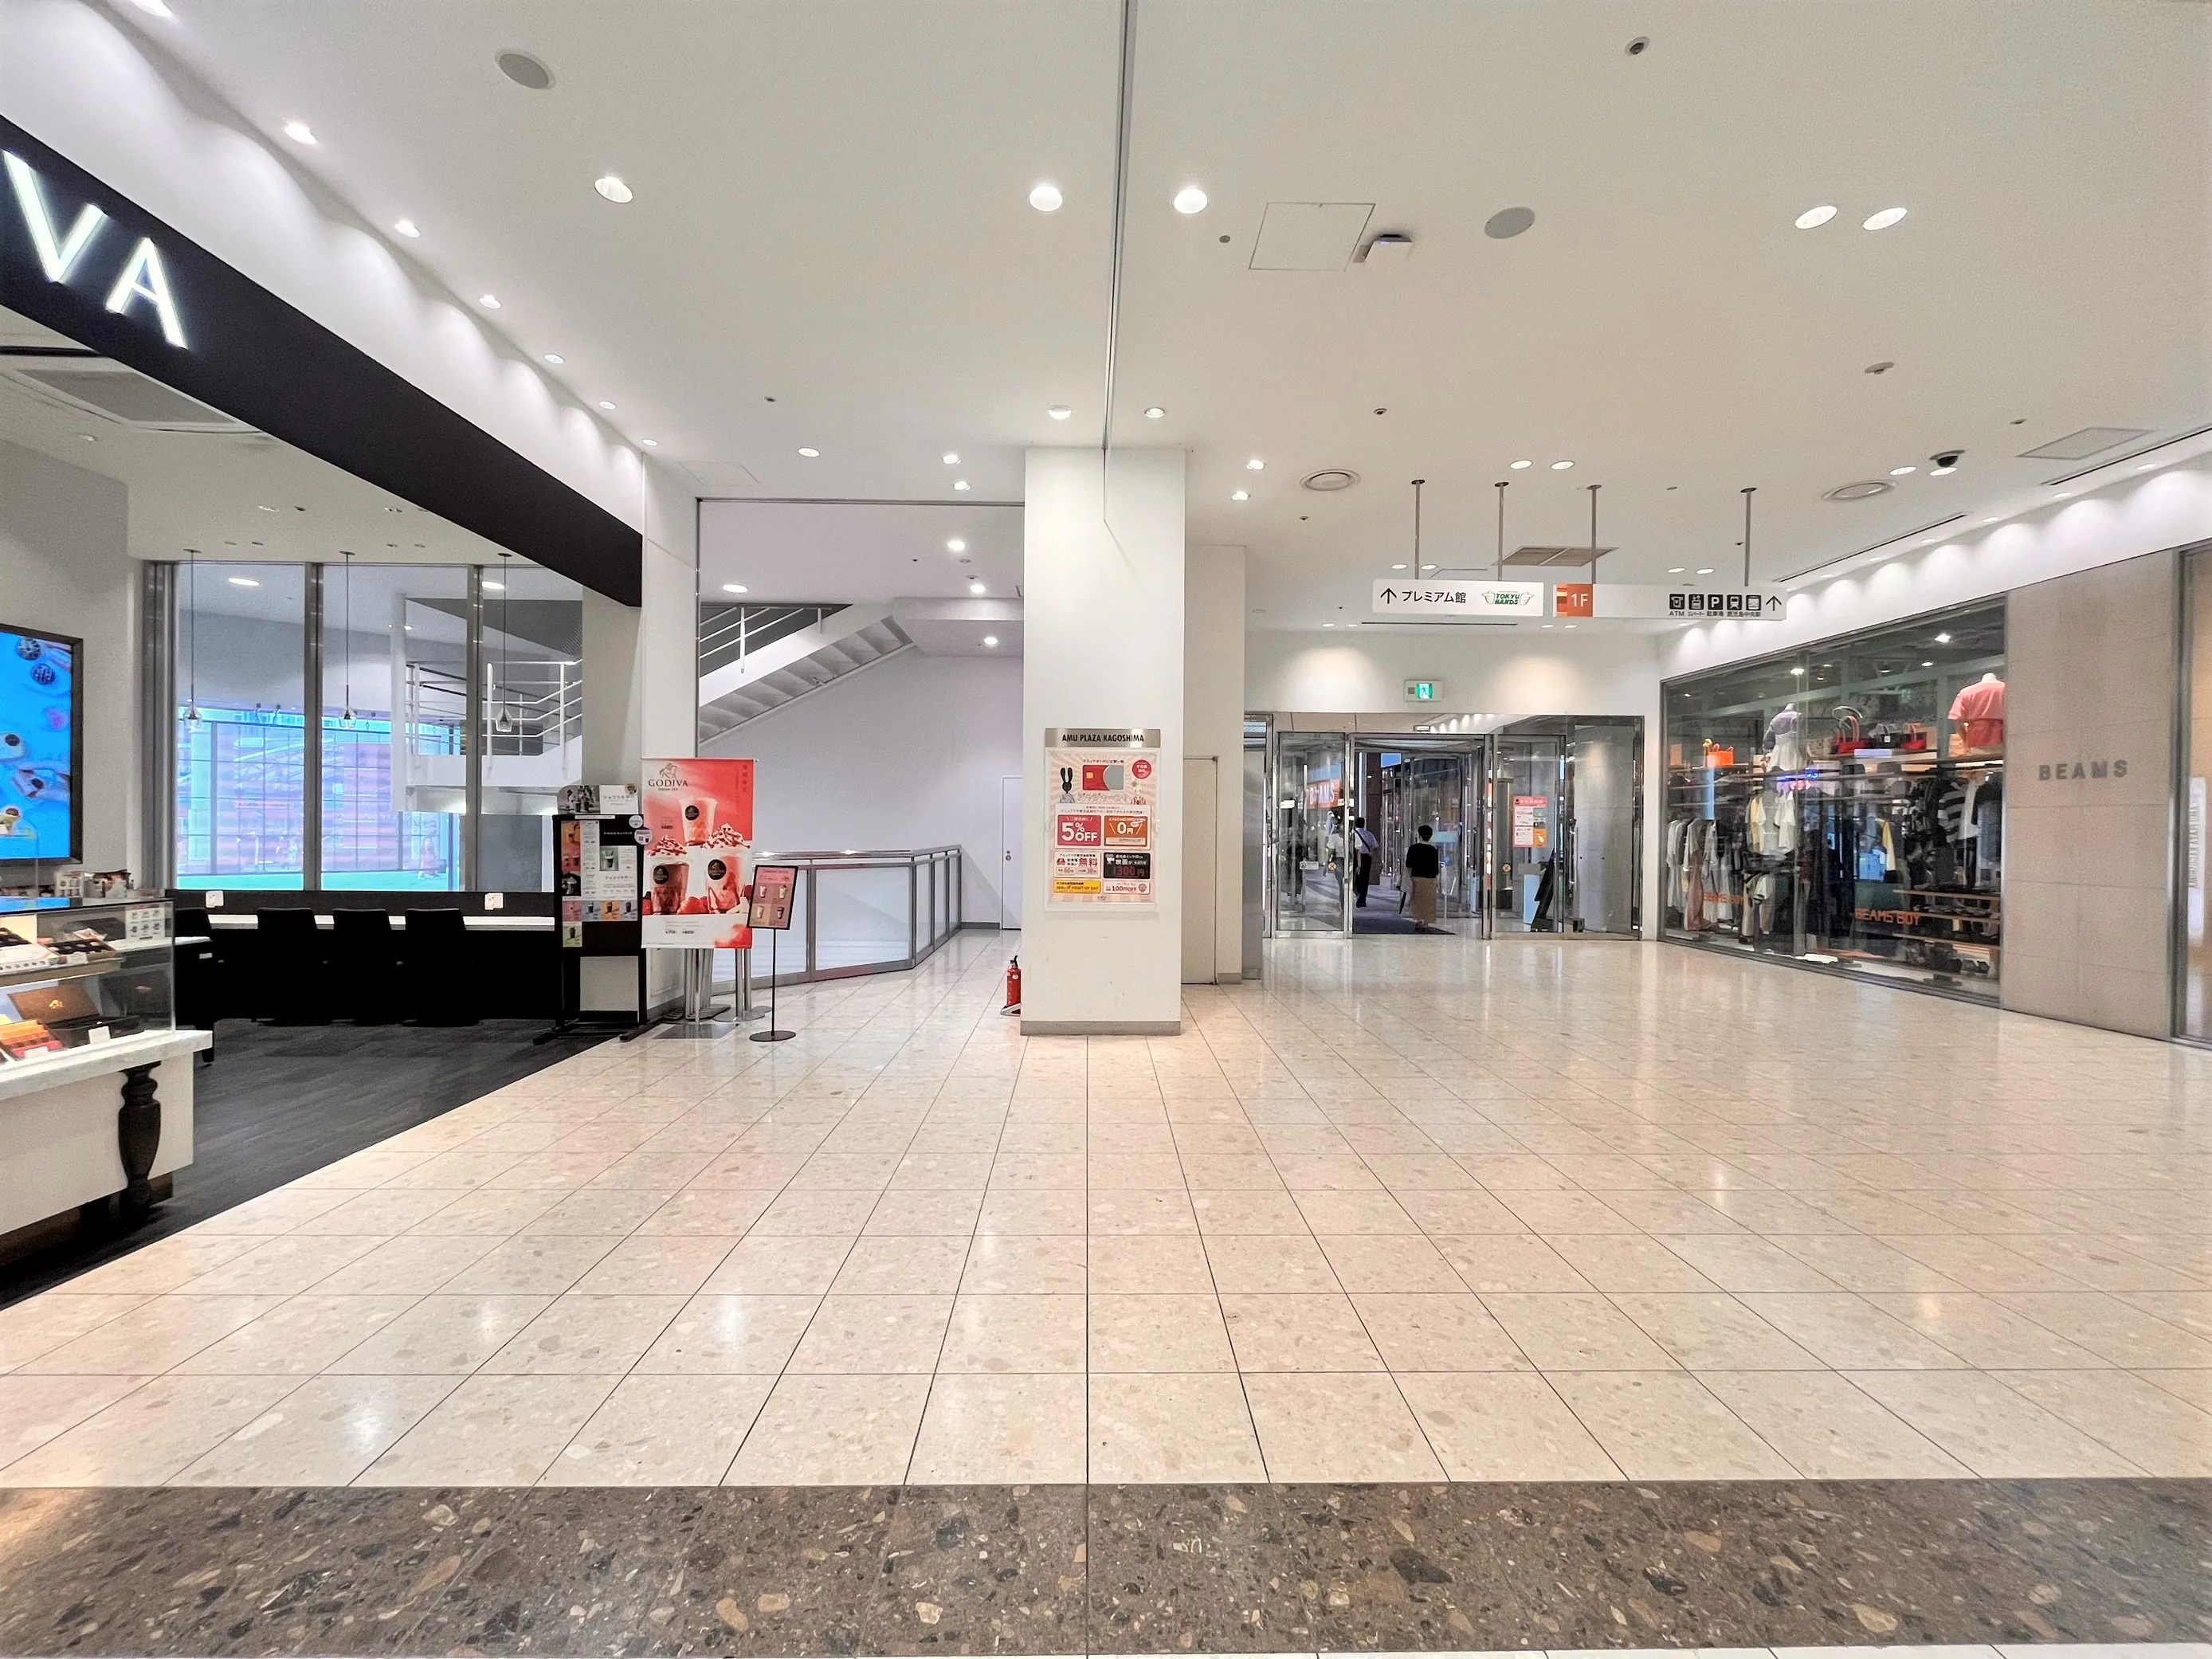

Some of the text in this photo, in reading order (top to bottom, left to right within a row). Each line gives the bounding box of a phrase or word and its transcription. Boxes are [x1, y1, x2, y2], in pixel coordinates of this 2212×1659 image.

[2, 148, 189, 350] VA
[1402, 590, 1467, 604] プレミアム館
[1571, 593, 1588, 607] 1F
[2038, 759, 2128, 781] BEAMS
[648, 779, 688, 787] GODIVA
[1854, 908, 1894, 924] BEAMS
